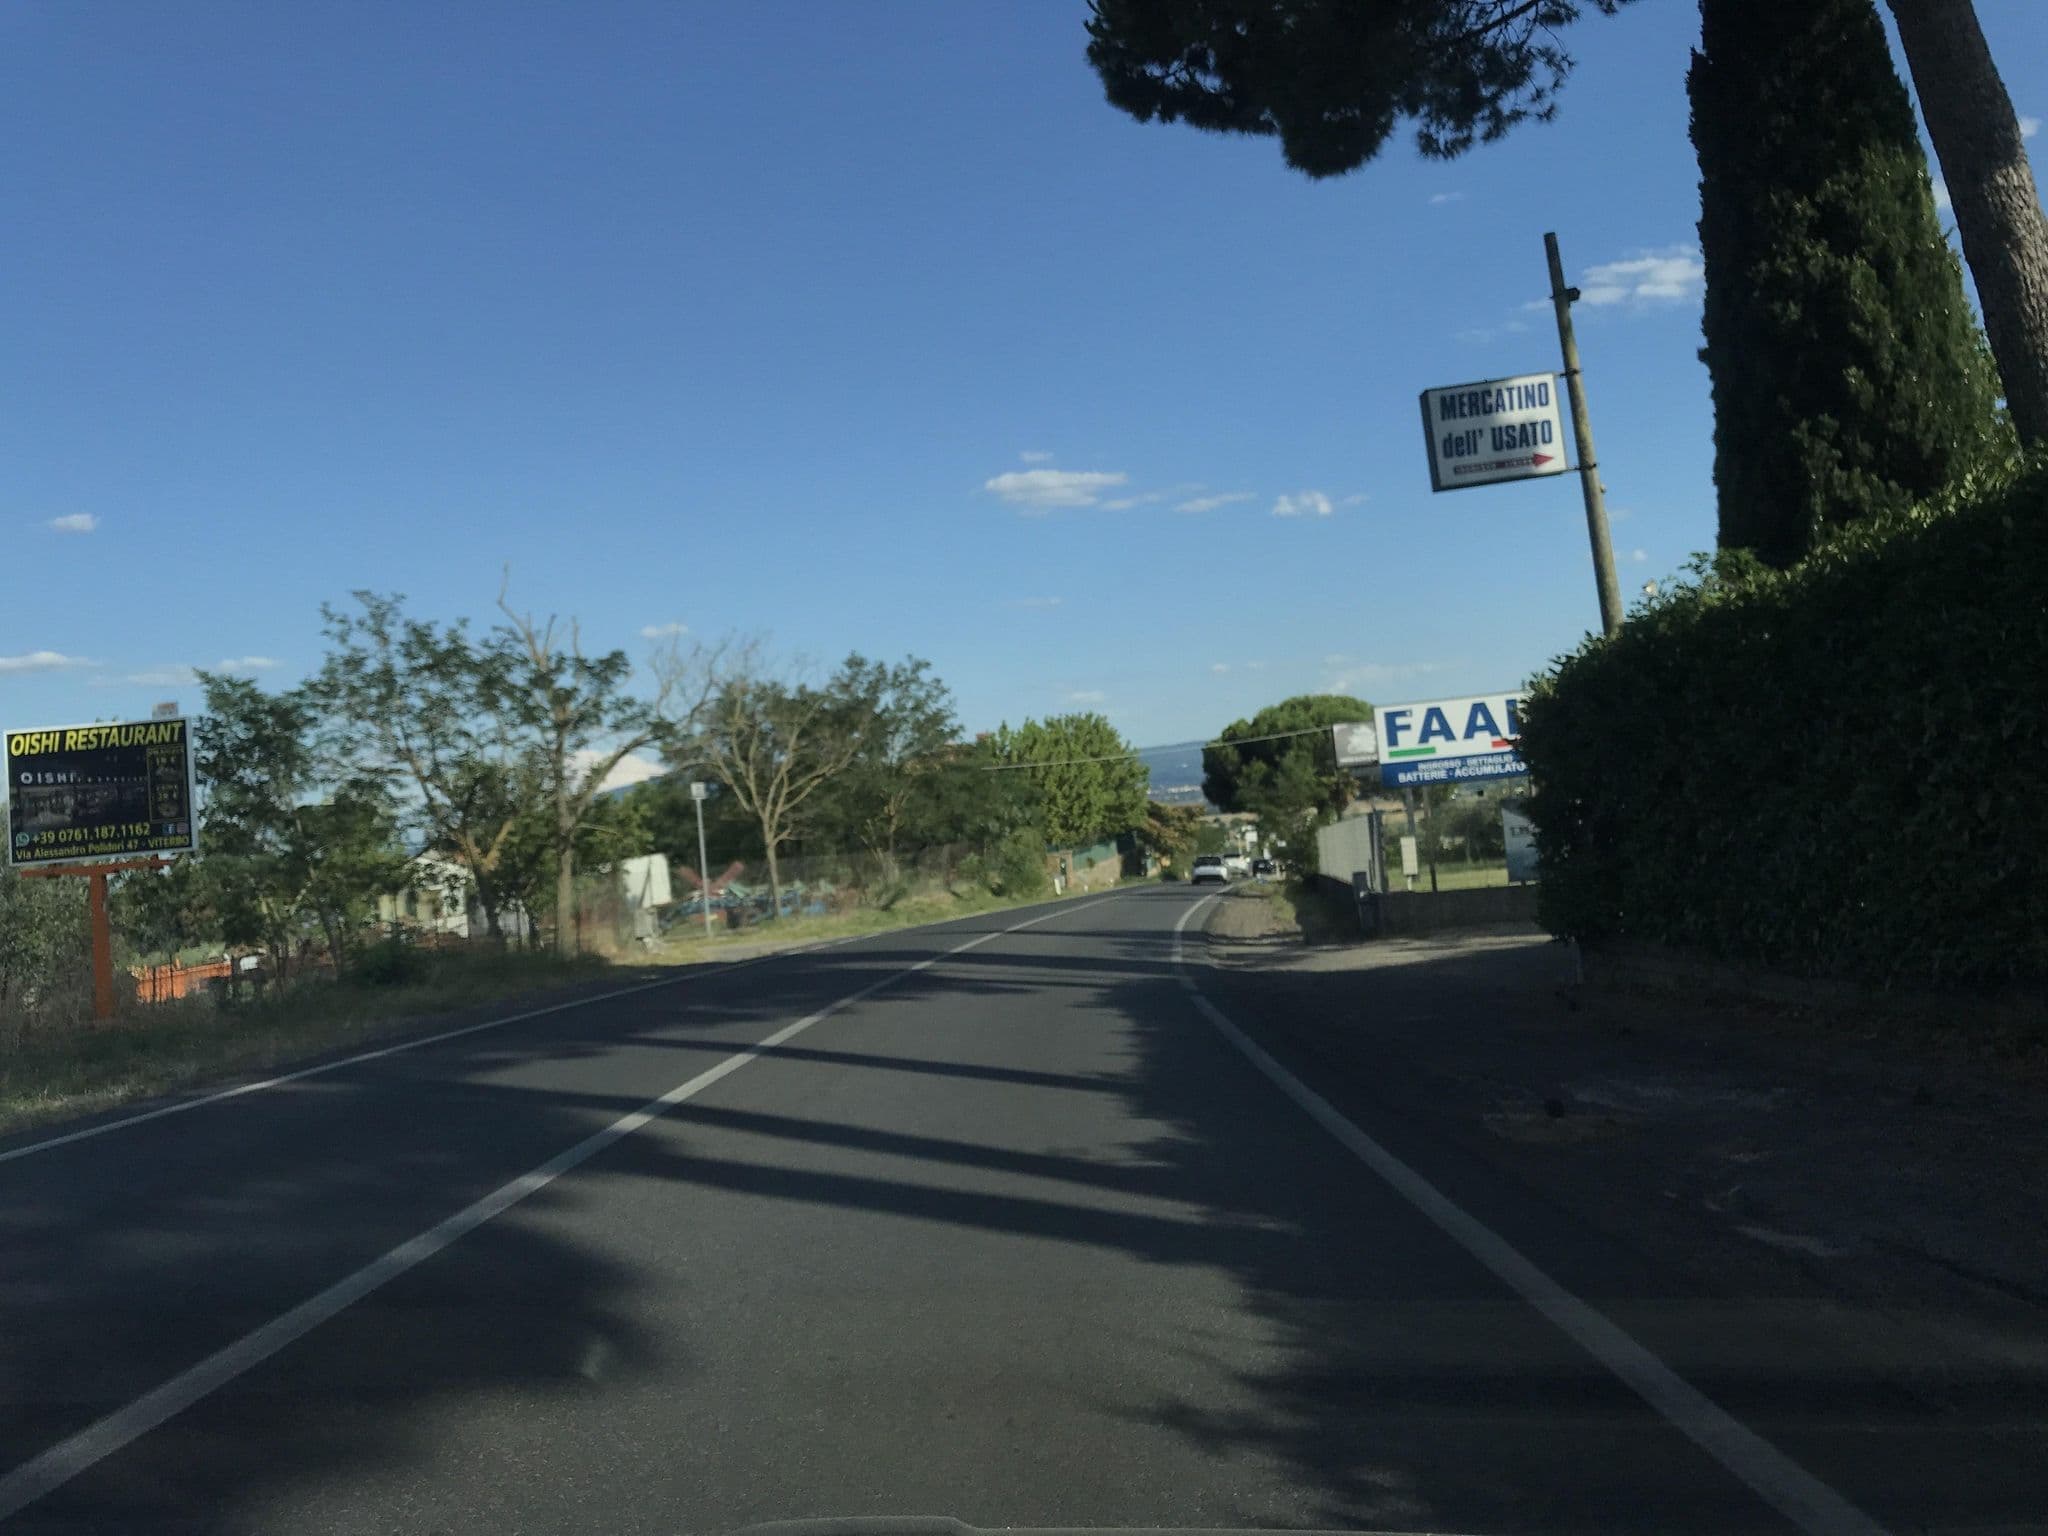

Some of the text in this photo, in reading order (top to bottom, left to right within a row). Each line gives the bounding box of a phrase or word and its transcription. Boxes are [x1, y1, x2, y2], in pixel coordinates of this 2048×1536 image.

[1440, 382, 1549, 421] MERCATINO
[1443, 420, 1552, 458] dell' USATO
[10, 721, 183, 756] OISHI RESTAURANT
[1384, 699, 1519, 747] FAA
[1398, 769, 1448, 784] BATTERIE
[1455, 762, 1527, 779] ACCUMULATO
[15, 849, 31, 860] Via
[34, 844, 86, 858] Alessandro
